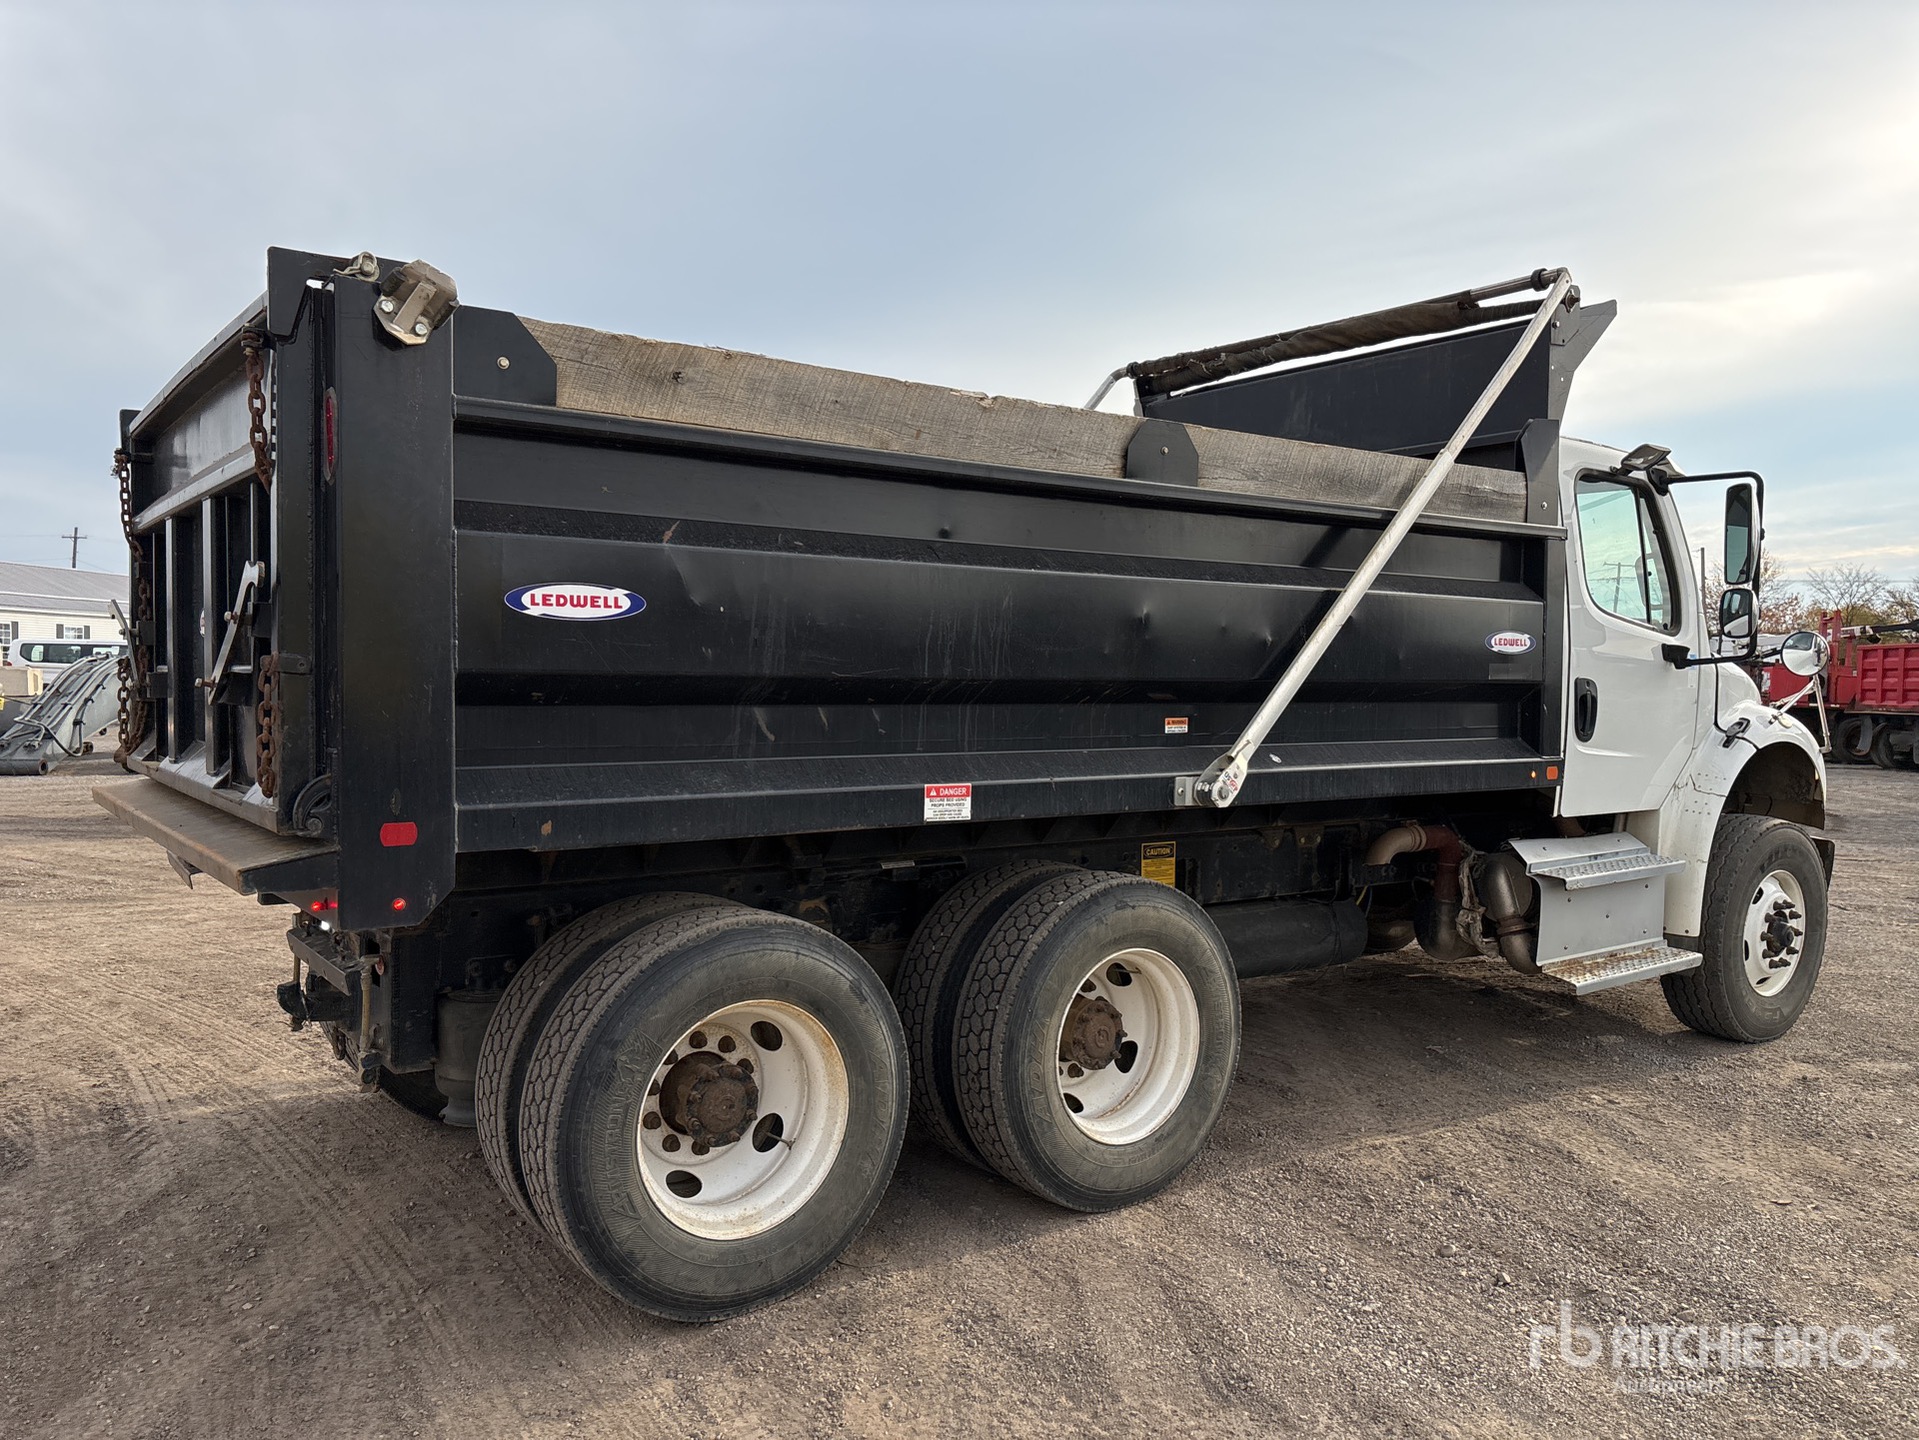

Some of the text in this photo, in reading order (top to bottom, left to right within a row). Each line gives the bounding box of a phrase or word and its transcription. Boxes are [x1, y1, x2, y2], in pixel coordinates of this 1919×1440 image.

[530, 593, 623, 609] LEDWELL
[1494, 638, 1528, 647] LEDWELL
[939, 787, 967, 796] DANGER
[1146, 848, 1170, 856] CAUTION
